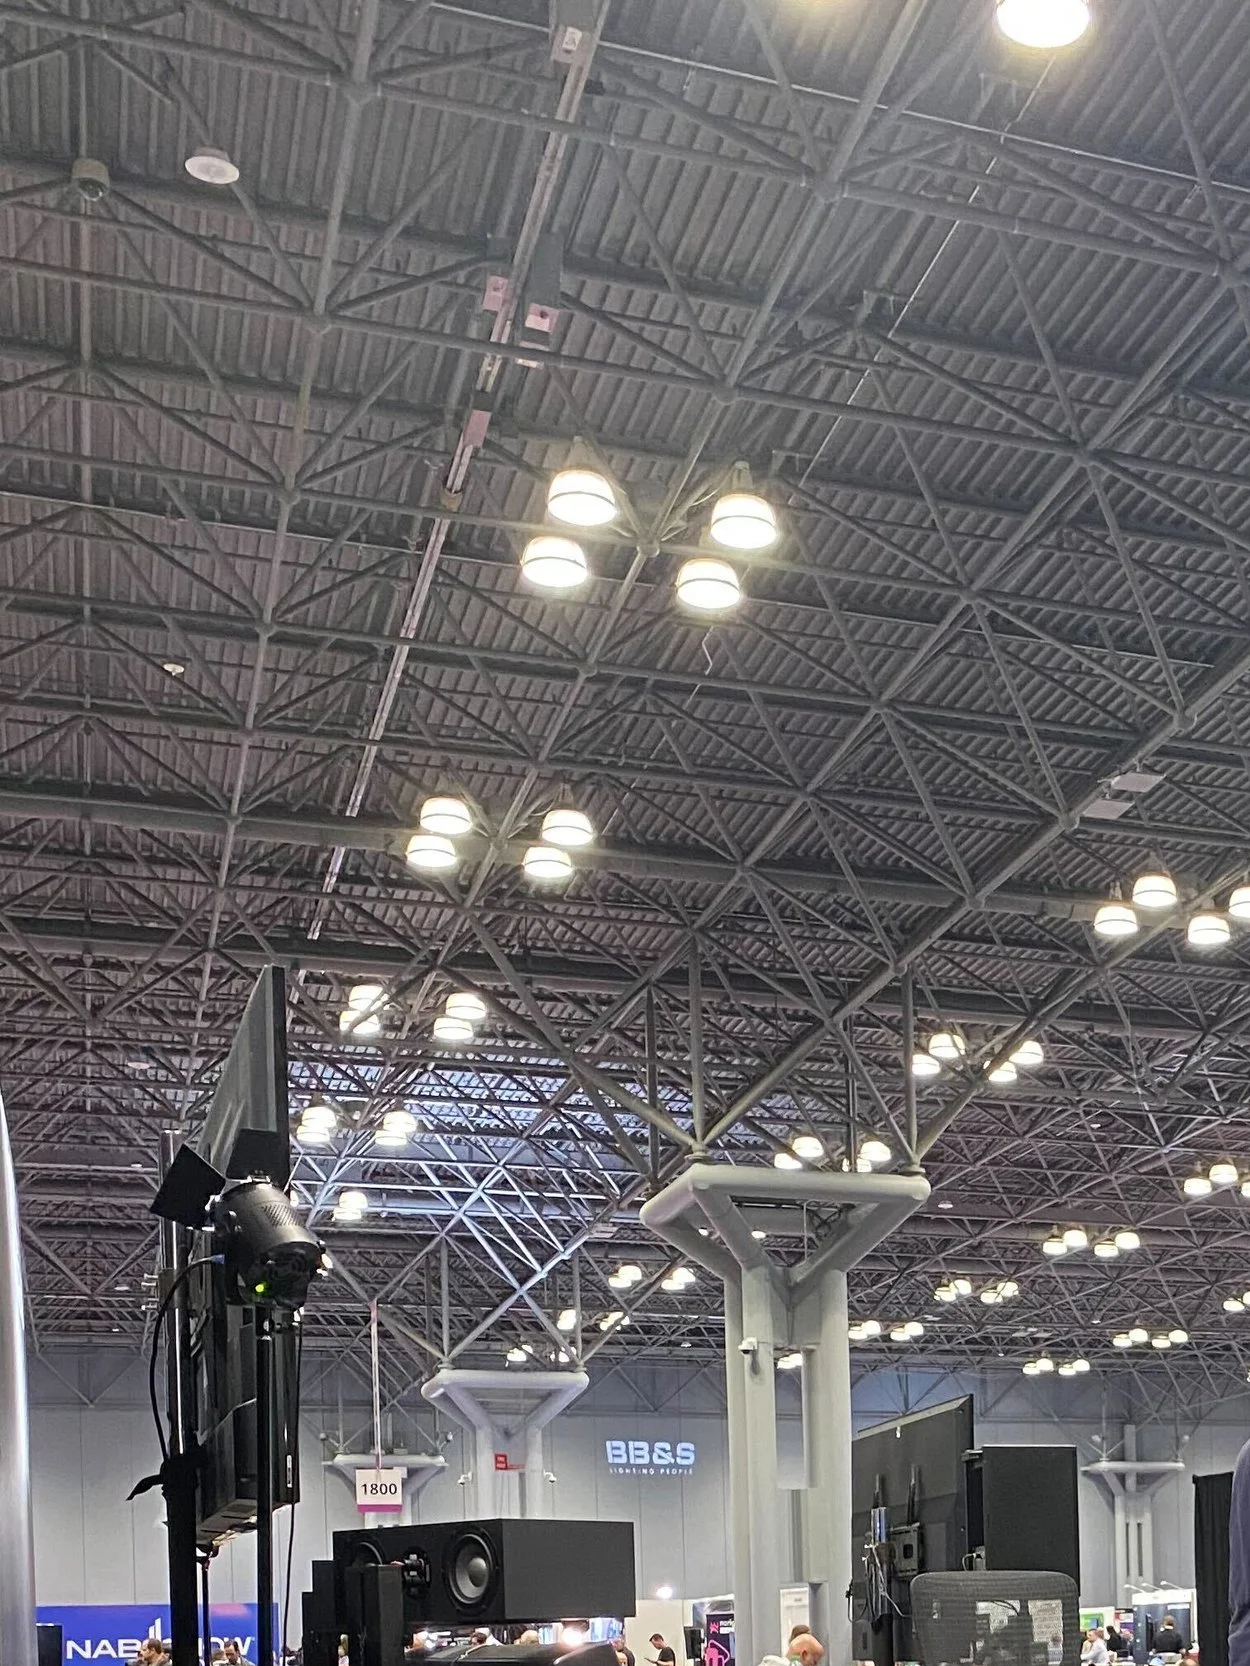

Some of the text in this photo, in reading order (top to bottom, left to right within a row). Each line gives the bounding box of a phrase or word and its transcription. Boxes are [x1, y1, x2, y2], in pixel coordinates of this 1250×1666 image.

[606, 1440, 695, 1465] BB&S
[361, 1483, 398, 1496] 1800
[66, 1638, 143, 1660] NAB
